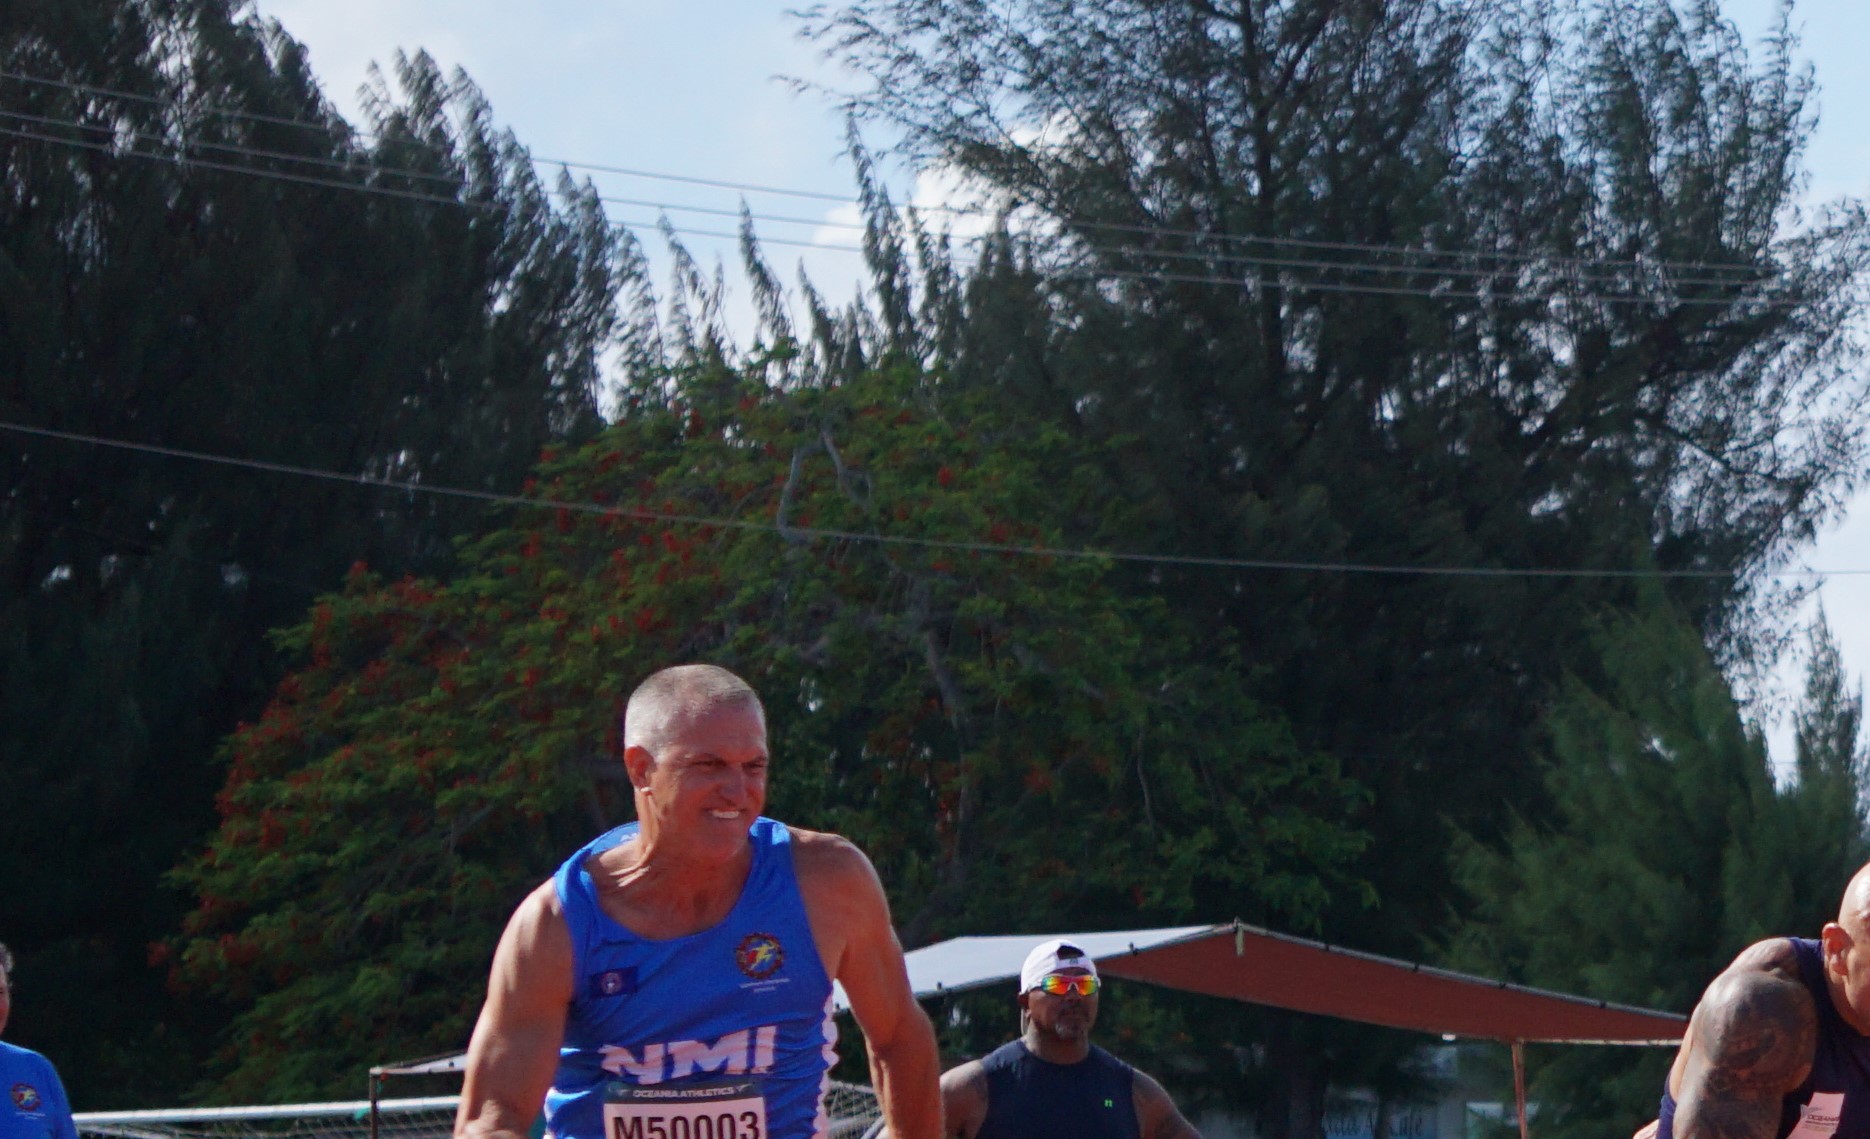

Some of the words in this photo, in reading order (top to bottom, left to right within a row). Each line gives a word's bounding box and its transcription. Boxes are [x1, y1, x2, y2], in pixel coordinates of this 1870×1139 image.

[597, 1025, 778, 1084] NMI
[633, 1088, 680, 1098] OCEANIA
[680, 1086, 734, 1097] ATHLETICS
